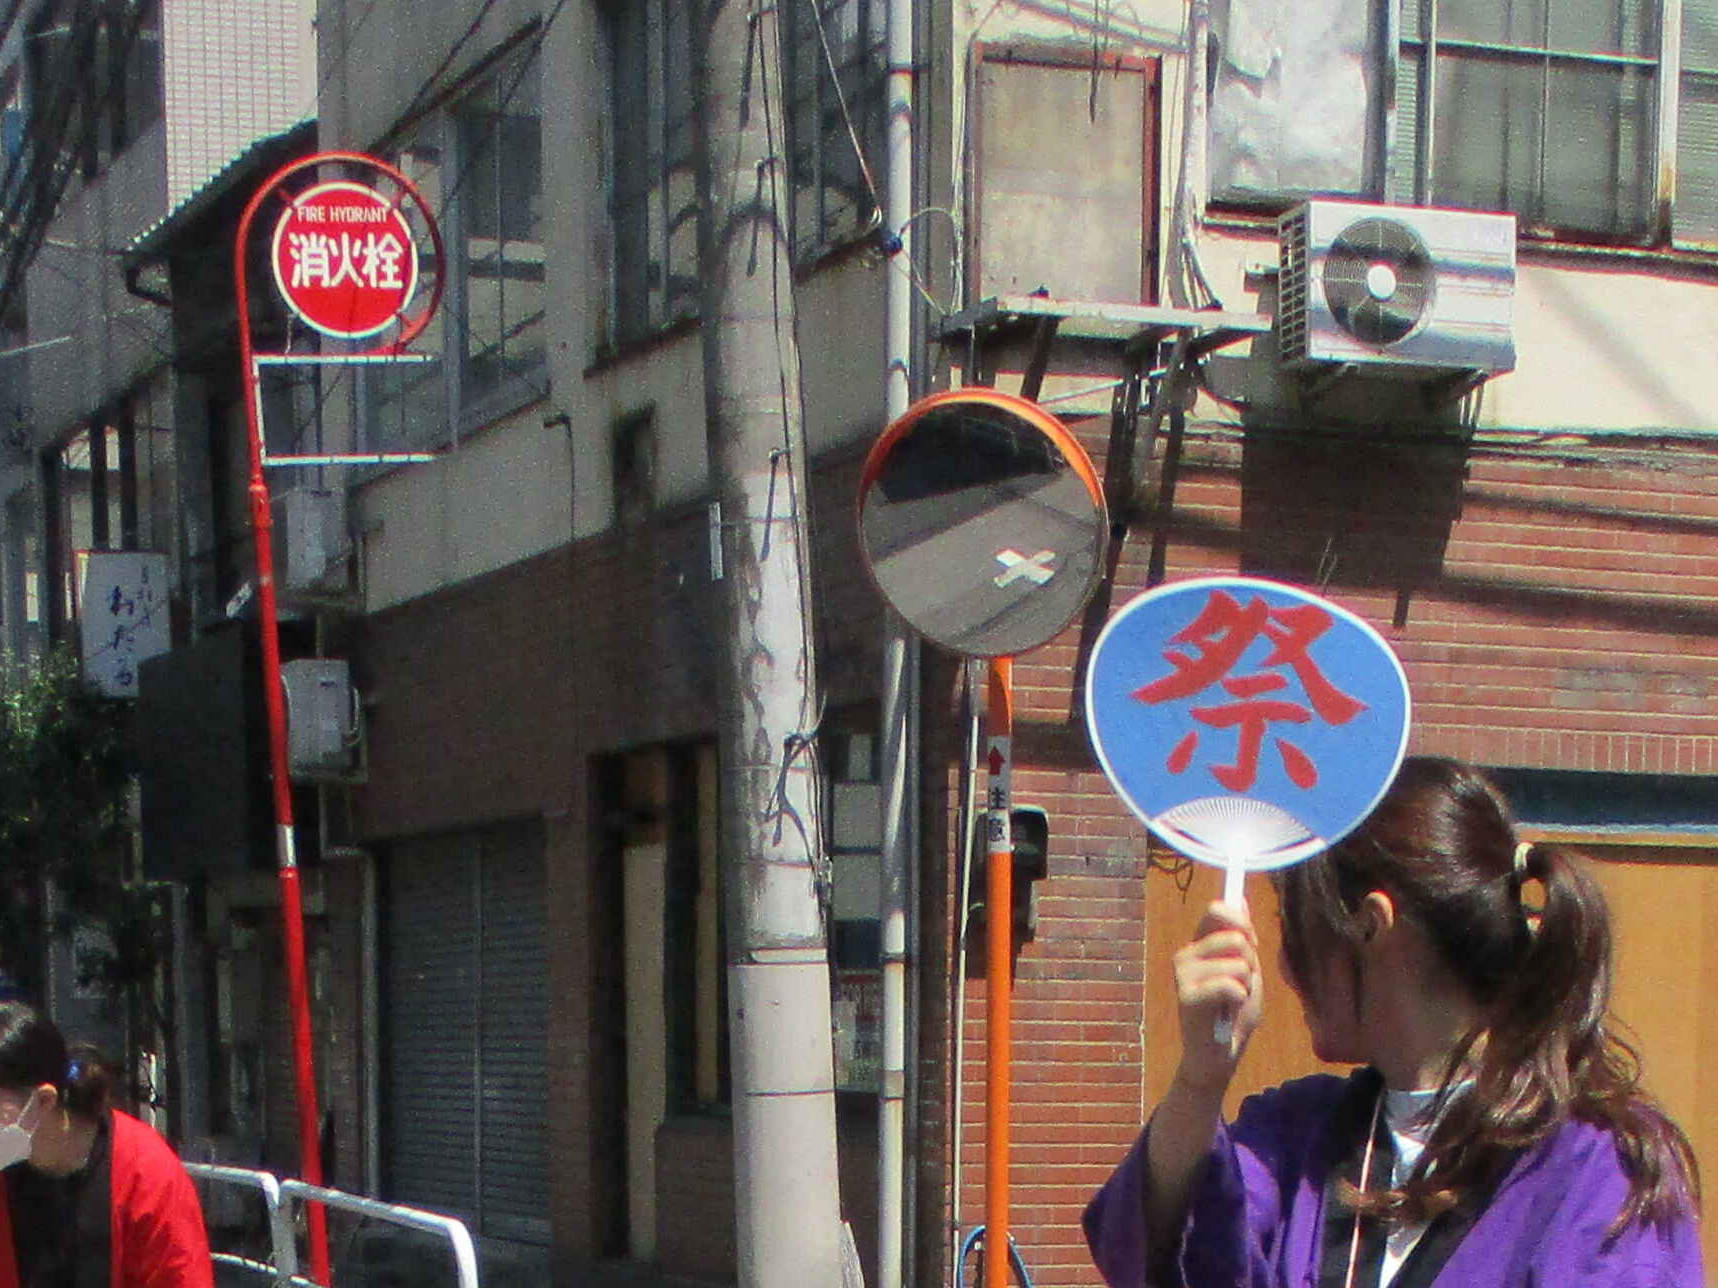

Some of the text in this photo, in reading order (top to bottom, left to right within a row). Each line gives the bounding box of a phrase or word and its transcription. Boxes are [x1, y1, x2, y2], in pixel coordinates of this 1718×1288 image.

[297, 206, 389, 223] FIRE HYDRANT
[288, 231, 405, 289] 消火栓
[1130, 589, 1371, 793] 祭
